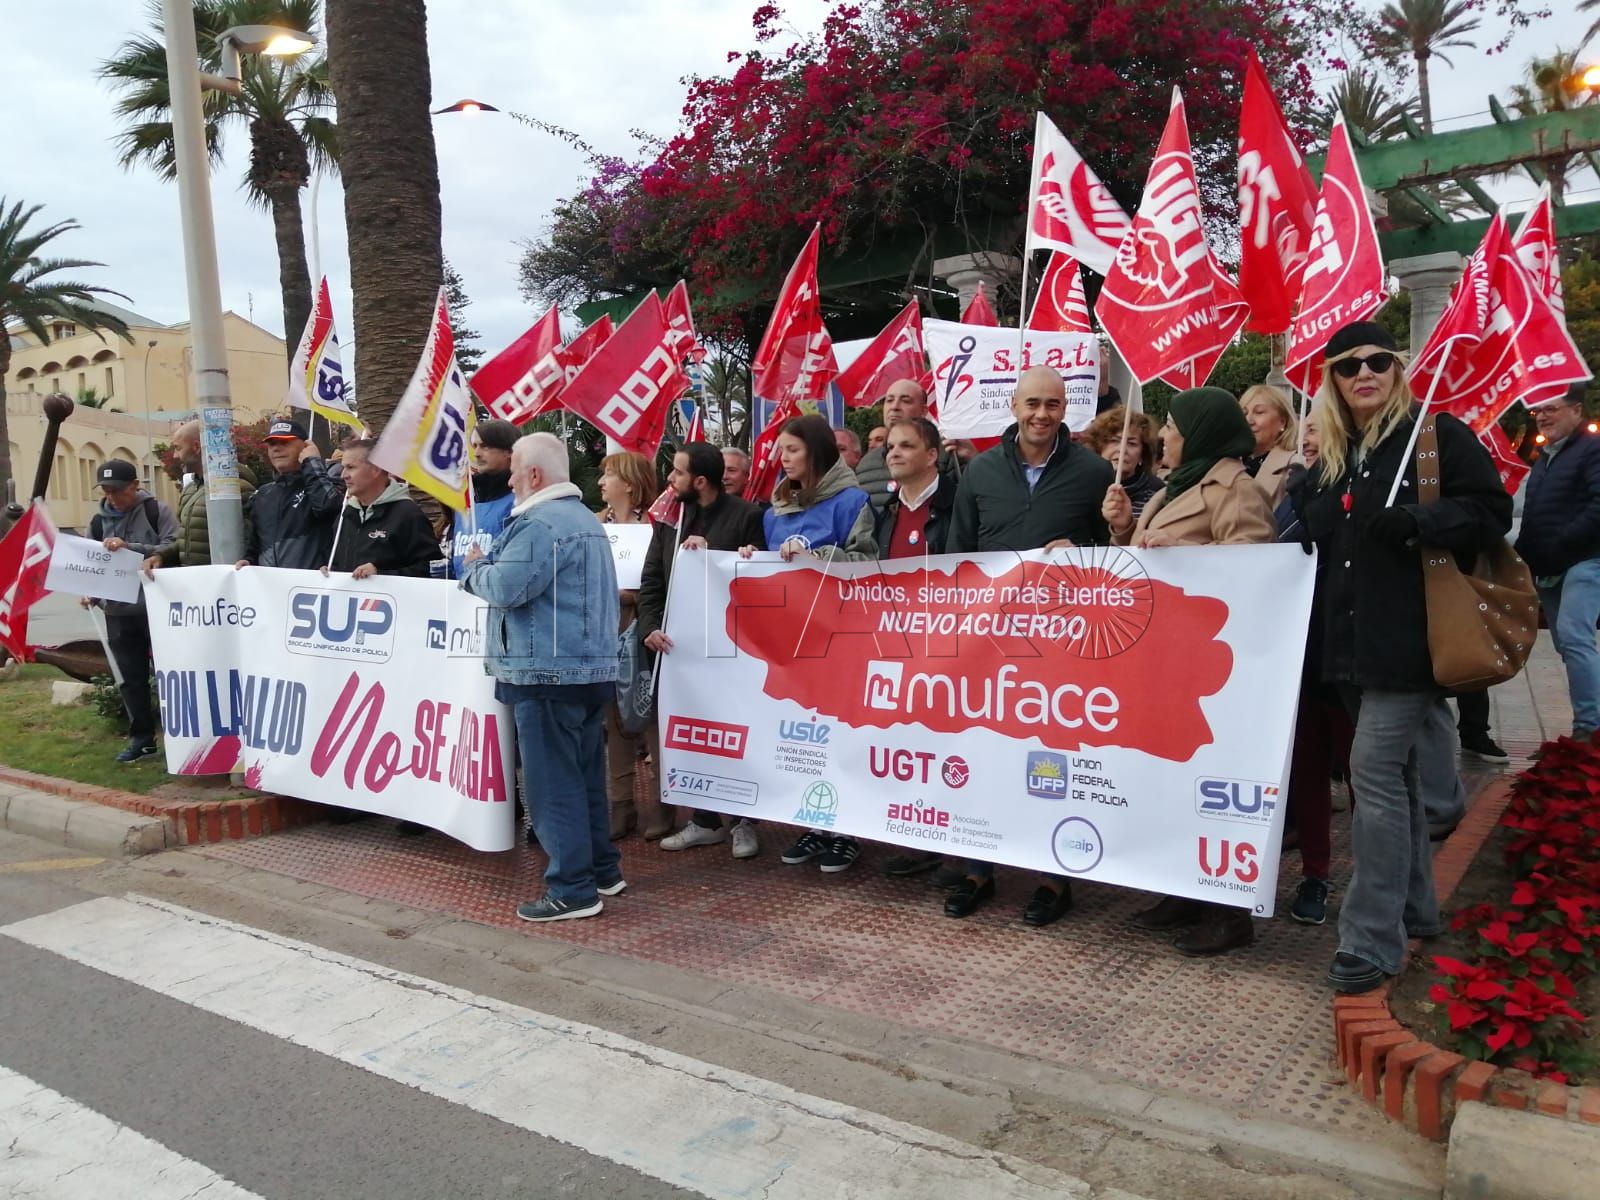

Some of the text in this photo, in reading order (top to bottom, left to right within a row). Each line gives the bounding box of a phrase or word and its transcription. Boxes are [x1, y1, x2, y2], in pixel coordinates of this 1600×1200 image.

[980, 388, 1016, 398] Sindicat
[838, 581, 1135, 609] Unidos, siempre más fuertes
[290, 592, 394, 645] SUP
[878, 611, 1087, 640] NUEVO ACUERDO
[905, 664, 1120, 733] muface
[155, 670, 201, 738] CON
[206, 669, 244, 737] LA
[243, 675, 307, 756] ALUD
[411, 699, 452, 783] SE
[672, 724, 742, 751] CCOO
[783, 755, 827, 768] INSPECTORES
[798, 748, 828, 760] SINDICAL
[869, 745, 936, 784] UGT
[680, 775, 713, 792] SIAT
[1028, 775, 1065, 792] UFP
[1072, 774, 1116, 789] FEDERAL
[1072, 789, 1129, 807] DE POLICIA
[793, 808, 838, 826] ANPE
[885, 819, 948, 841] federación
[952, 825, 961, 833] de
[961, 837, 998, 850] Educación
